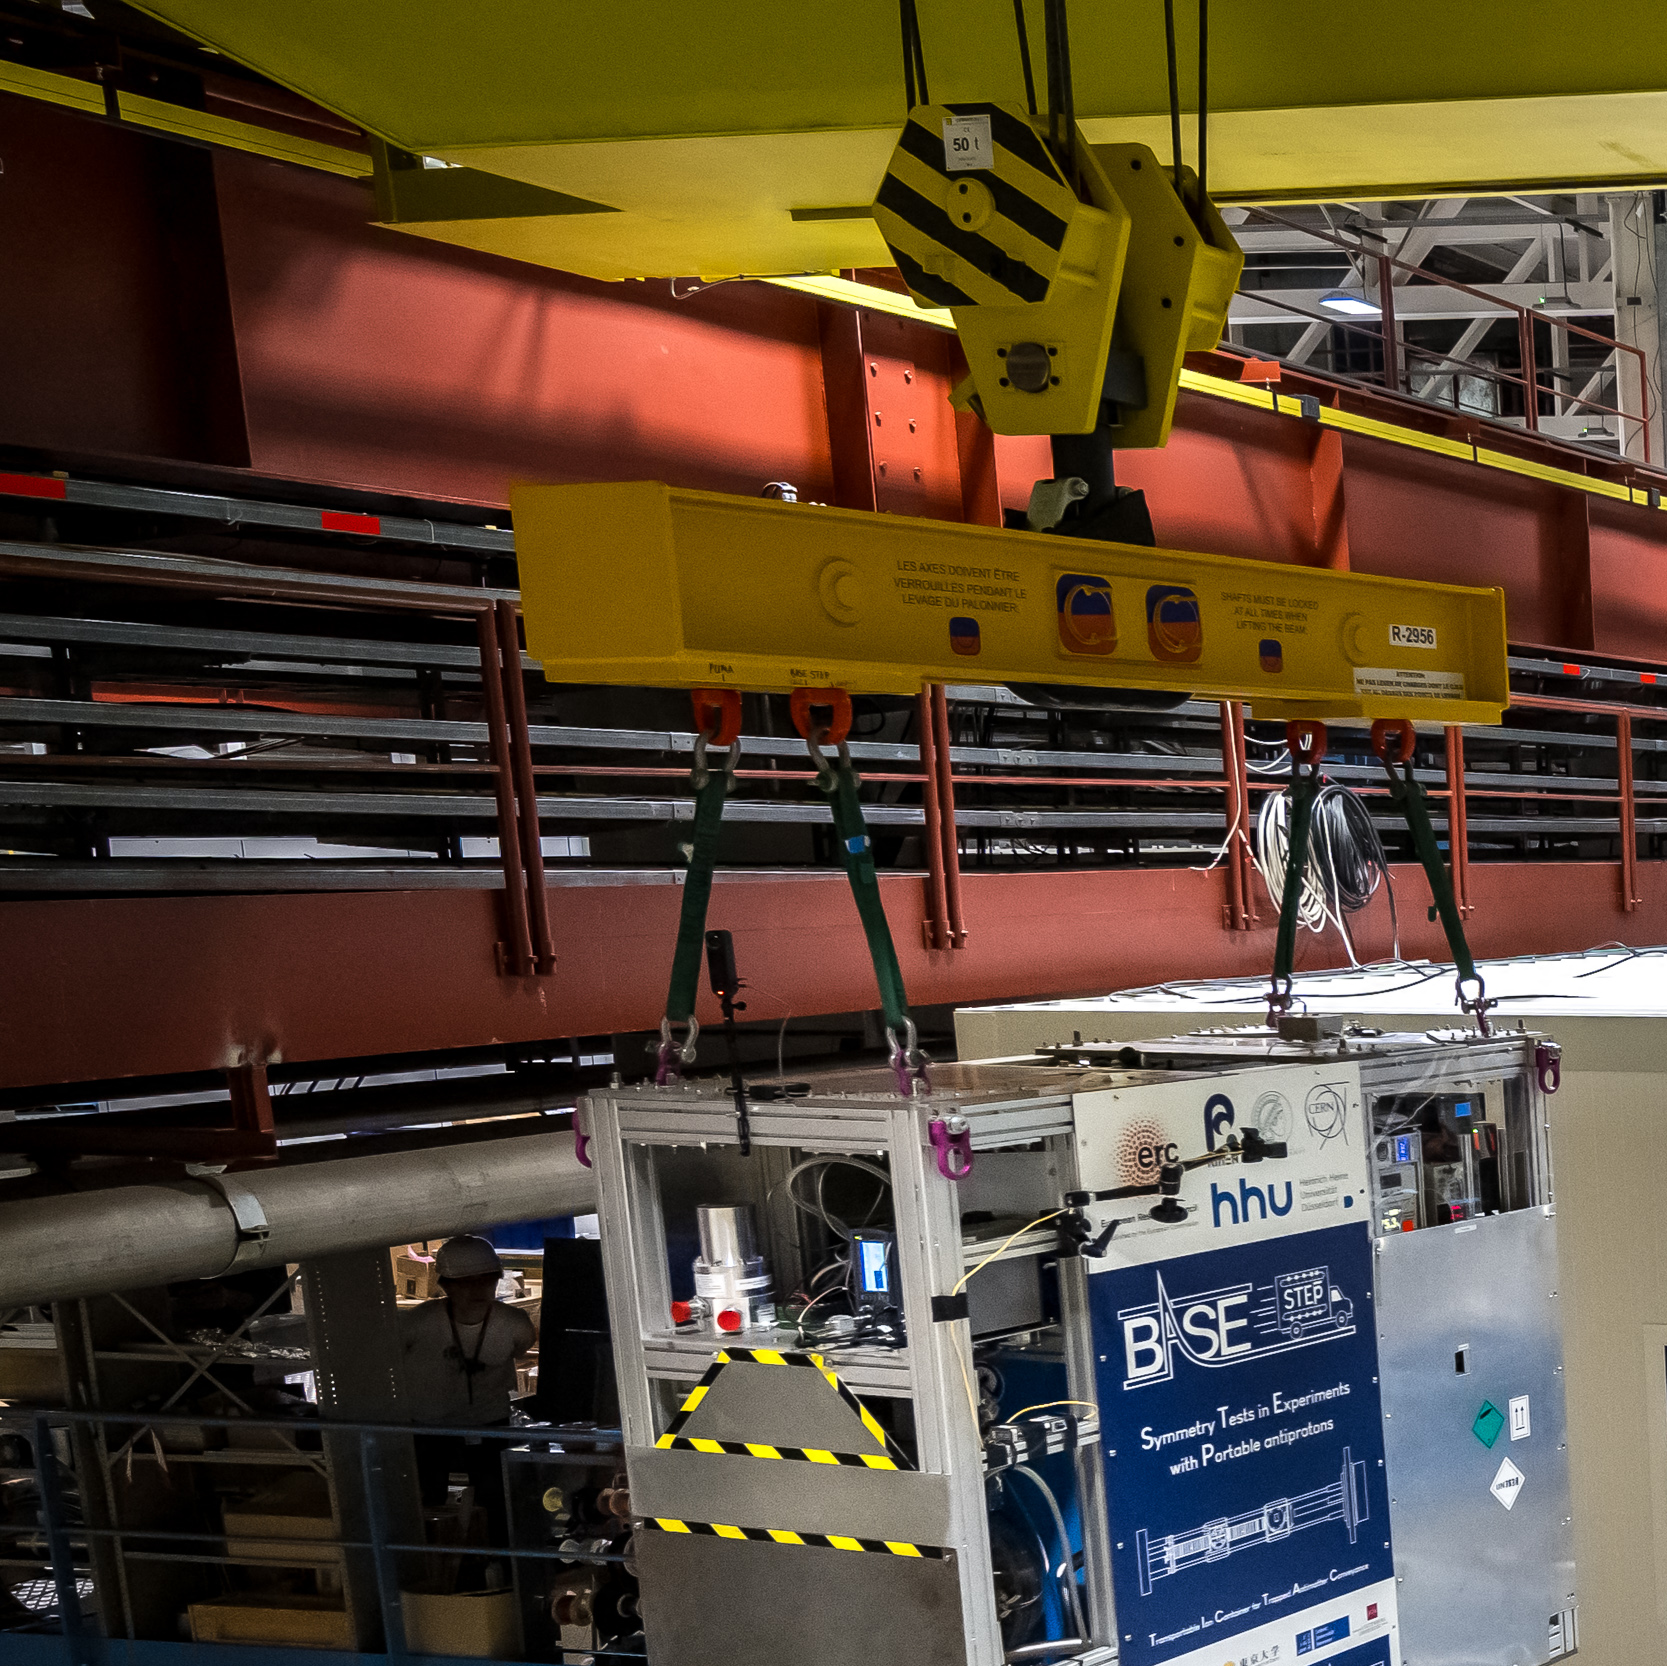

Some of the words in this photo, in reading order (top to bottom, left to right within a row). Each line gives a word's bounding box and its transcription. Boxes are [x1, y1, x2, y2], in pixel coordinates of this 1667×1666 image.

[953, 137, 970, 152] 50
[897, 560, 917, 572] LES
[919, 563, 946, 575] AXES
[949, 565, 991, 579] DOIVENT
[901, 594, 942, 607] LEVAGE
[945, 598, 960, 608] DU
[967, 584, 1013, 597] PENDANT
[1015, 588, 1027, 599] LE
[1221, 592, 1252, 604] SHAFTS
[1253, 595, 1275, 606] MUST
[1276, 597, 1287, 607] BE
[1289, 598, 1319, 610] LOCKED
[1234, 606, 1243, 616] AT
[1244, 607, 1259, 618] ALL
[1260, 608, 1284, 620] TIMES
[1285, 611, 1309, 622] WHEN
[1236, 620, 1267, 632] LIFTING
[1267, 622, 1283, 633] THE
[1391, 625, 1434, 645] R-2956
[1308, 1102, 1335, 1115] CERN
[1137, 1142, 1179, 1169] erc
[1211, 1178, 1293, 1228] hhu
[1283, 1281, 1324, 1310] STEP
[1119, 1270, 1252, 1388] BASE
[1140, 1427, 1216, 1451] Symmetry
[1216, 1406, 1255, 1429] Tests
[1258, 1403, 1270, 1419] in
[1273, 1382, 1350, 1414] Experiments
[1170, 1455, 1198, 1476] with
[1201, 1440, 1260, 1467] Portable
[1264, 1418, 1334, 1448] antiprotons
